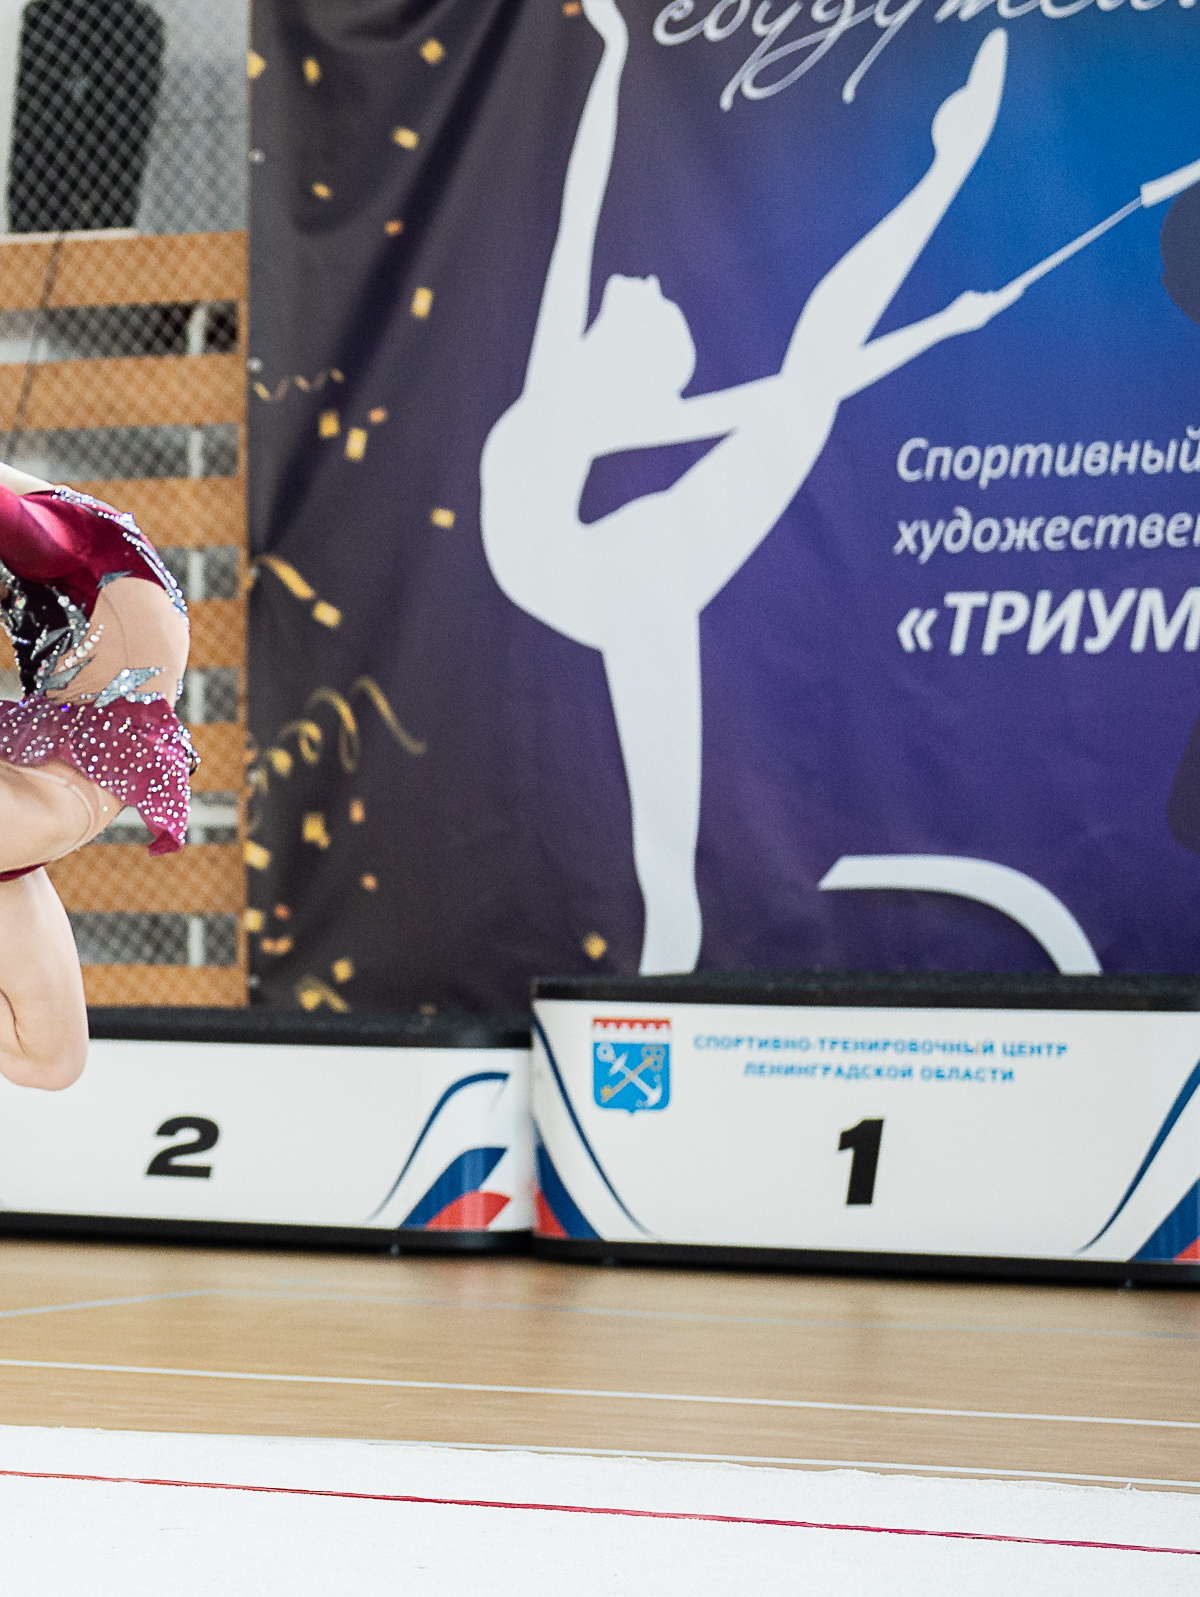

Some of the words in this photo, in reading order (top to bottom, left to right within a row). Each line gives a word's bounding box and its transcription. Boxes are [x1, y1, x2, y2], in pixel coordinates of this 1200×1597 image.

[897, 424, 1200, 490] Спортивный
[892, 505, 1200, 565] художестве
[743, 1060, 914, 1081] ЛЕНИНГРАДСКОЙ
[920, 1064, 1015, 1084] ОБЛАСТИ
[1001, 1040, 1069, 1059] ЦЕНТР
[145, 1115, 221, 1179] 2
[837, 1117, 885, 1206] 1
